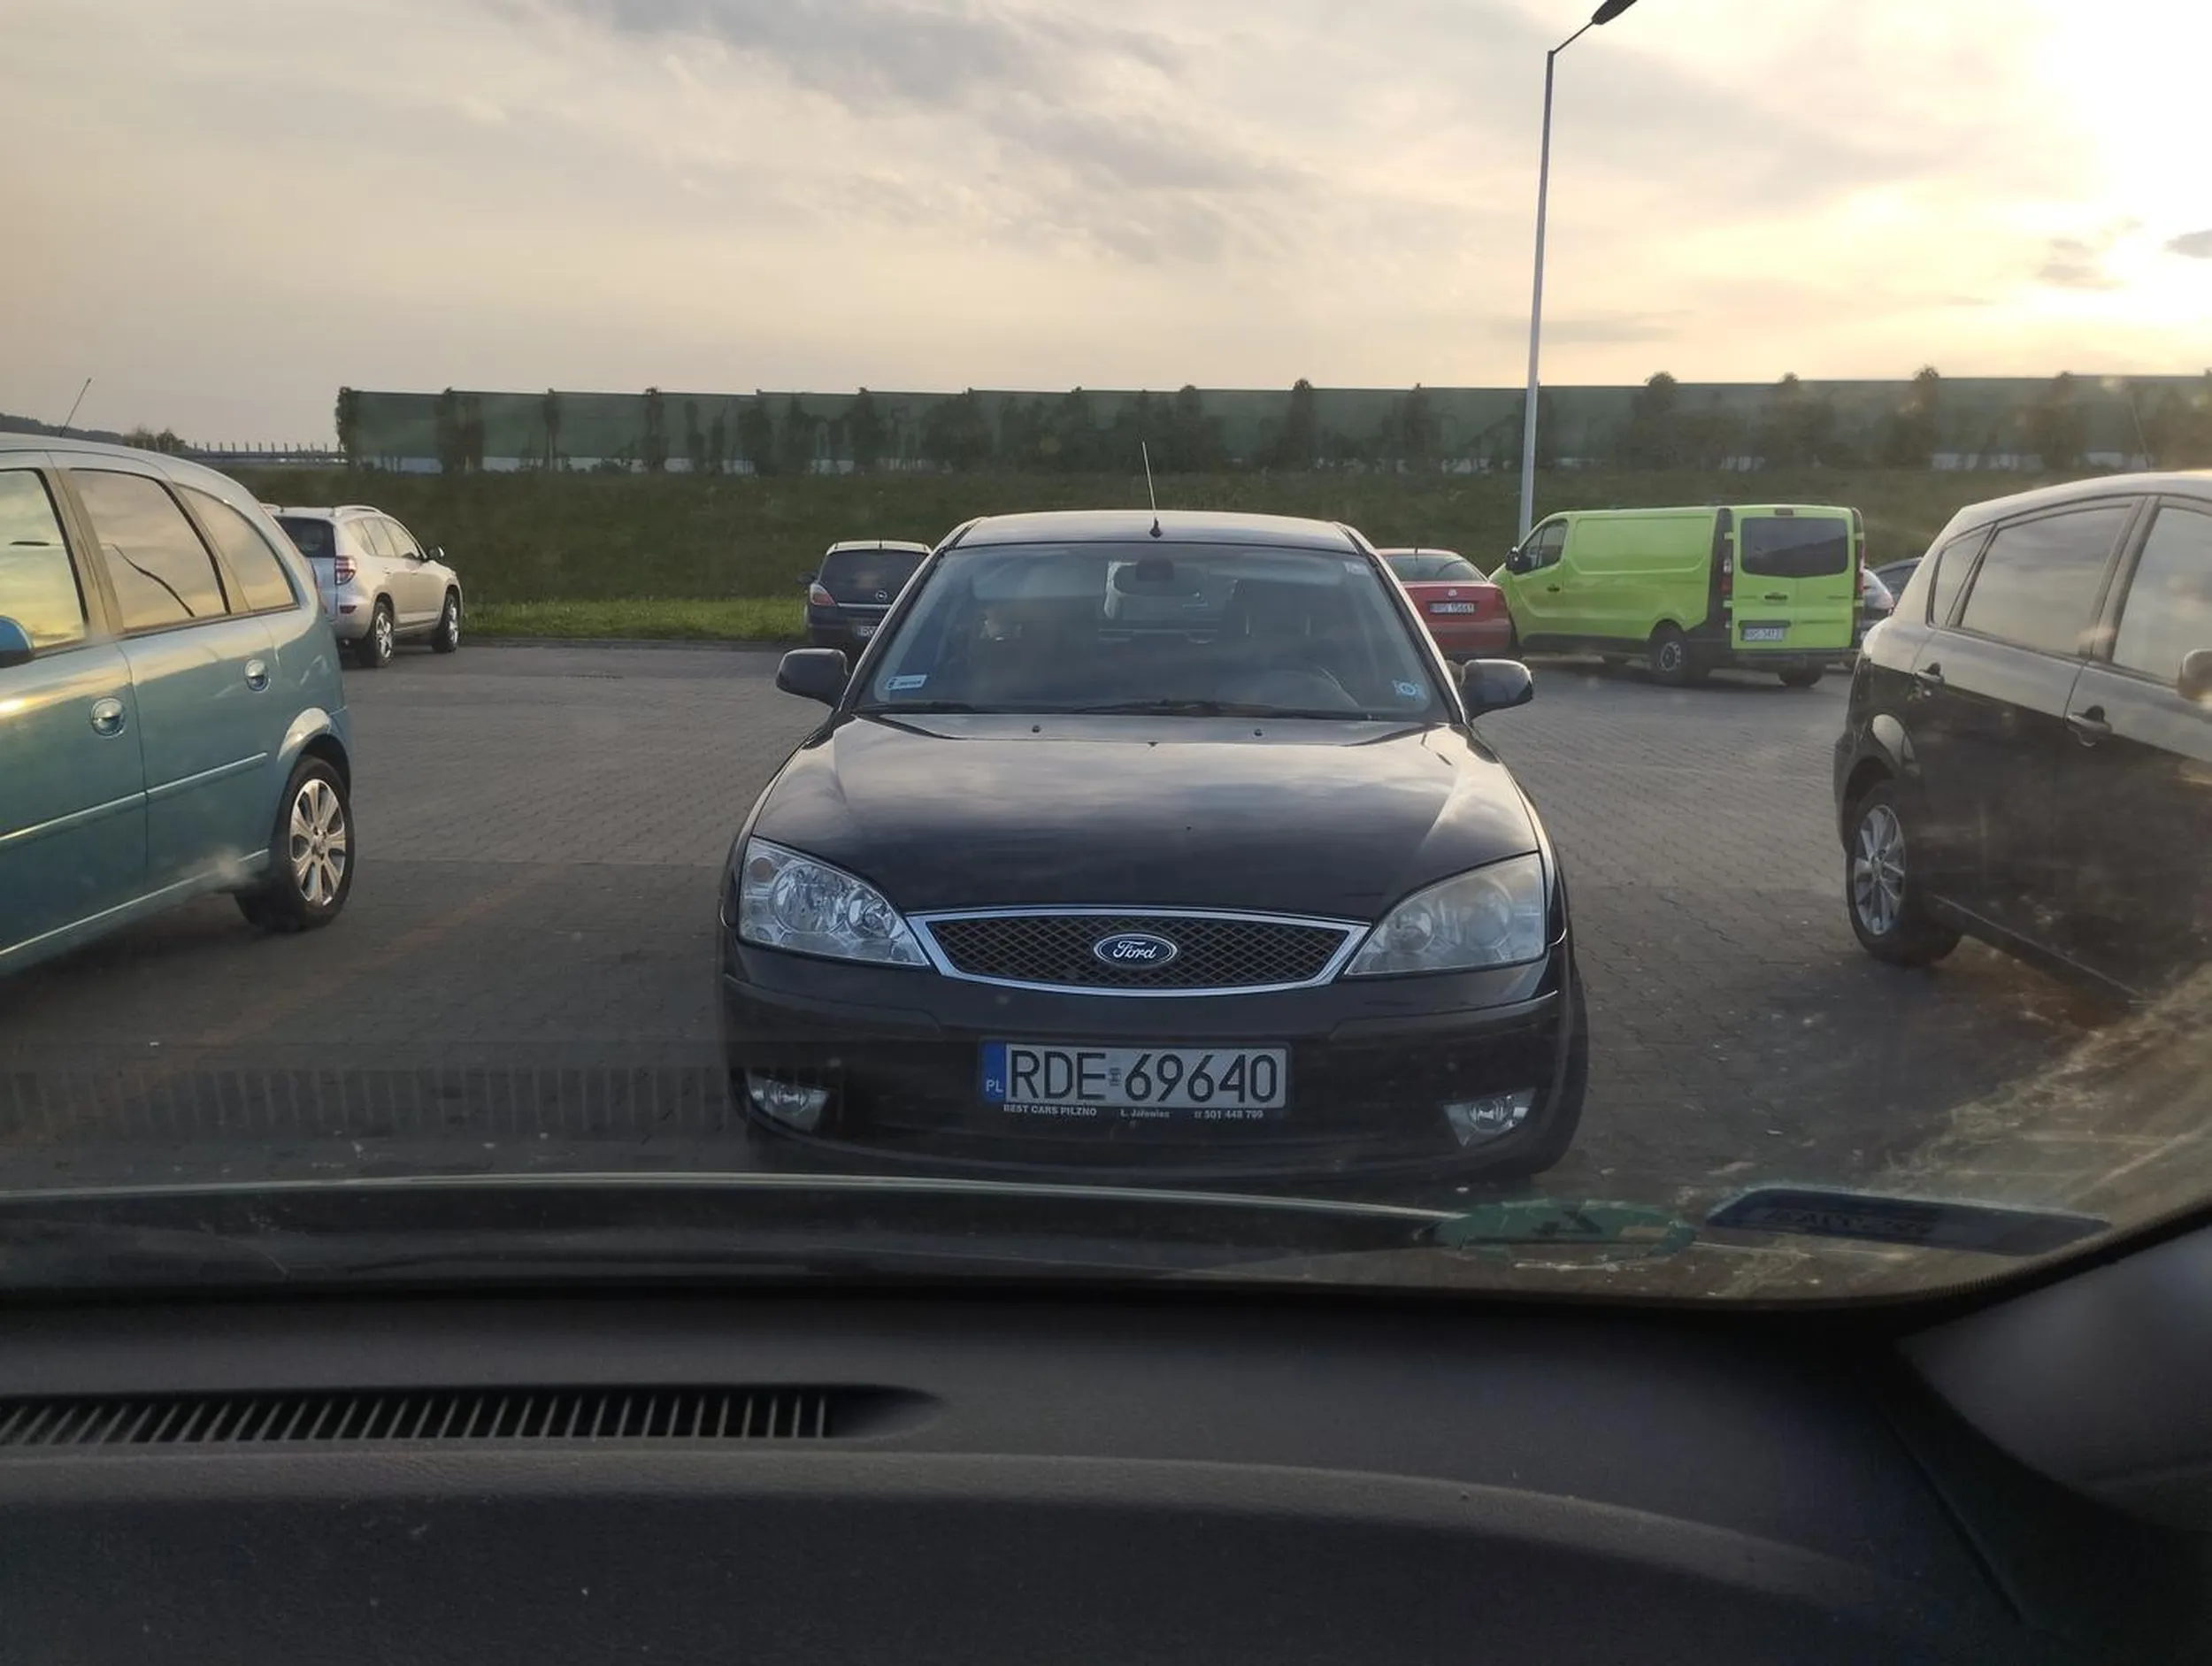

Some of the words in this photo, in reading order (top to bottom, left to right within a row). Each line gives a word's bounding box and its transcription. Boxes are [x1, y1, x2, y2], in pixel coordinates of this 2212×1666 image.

[1112, 940, 1158, 959] Ford
[1010, 1050, 1106, 1101] RDE
[1124, 1053, 1279, 1103] 69640
[985, 1079, 1004, 1094] PL
[1031, 1105, 1059, 1115] CARS
[1060, 1107, 1097, 1117] PILZNO
